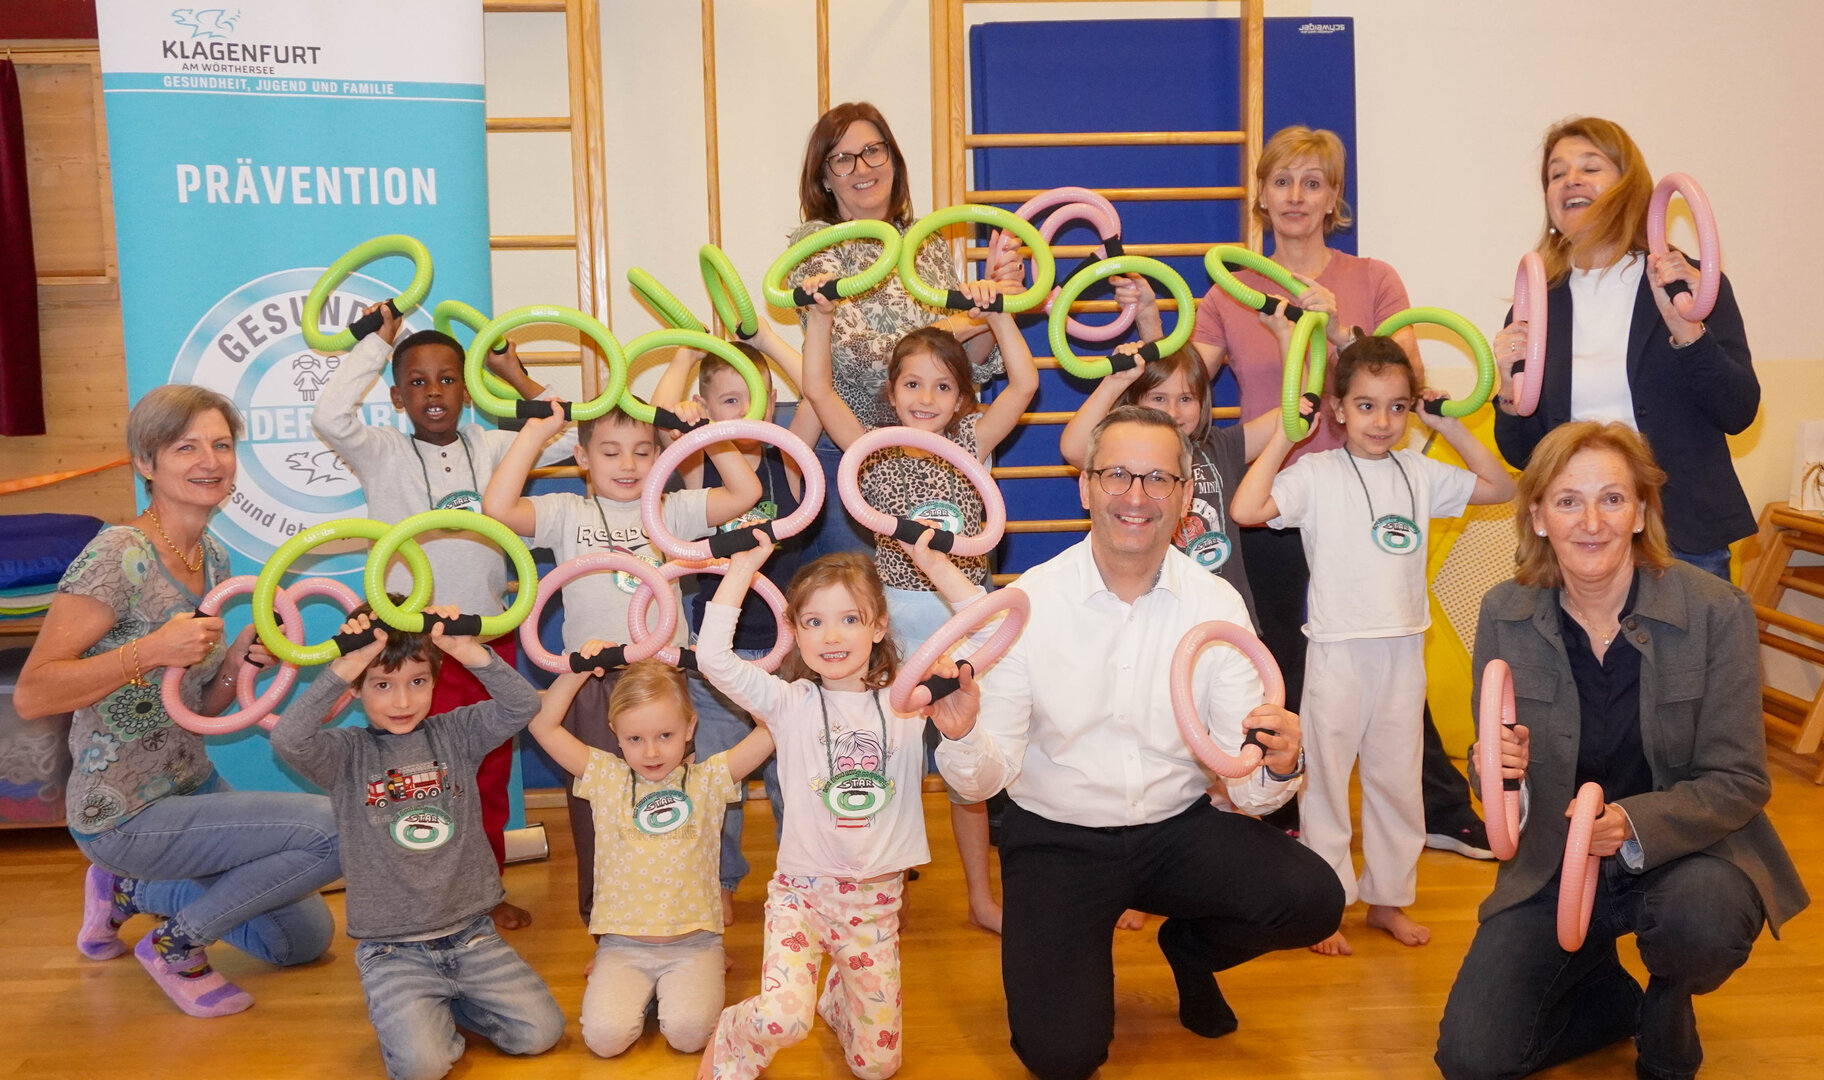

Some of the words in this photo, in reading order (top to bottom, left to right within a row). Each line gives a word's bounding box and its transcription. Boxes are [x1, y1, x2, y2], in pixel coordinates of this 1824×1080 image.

[1299, 23, 1345, 31] schweiger
[162, 40, 321, 65] KLAGENFURT
[182, 63, 199, 72] AM
[202, 62, 275, 75] WÖRTHERSEE
[163, 75, 252, 91] GESUNDHEIT,
[255, 80, 307, 93] JUGEND
[312, 82, 338, 93] UND
[343, 82, 395, 95] FAMILIE
[176, 158, 437, 205] PRÄVENTION
[229, 484, 277, 528] esund
[577, 525, 650, 546] Reeb
[836, 778, 875, 788] STAR
[643, 797, 676, 812] STAR
[405, 813, 440, 823] STAR
